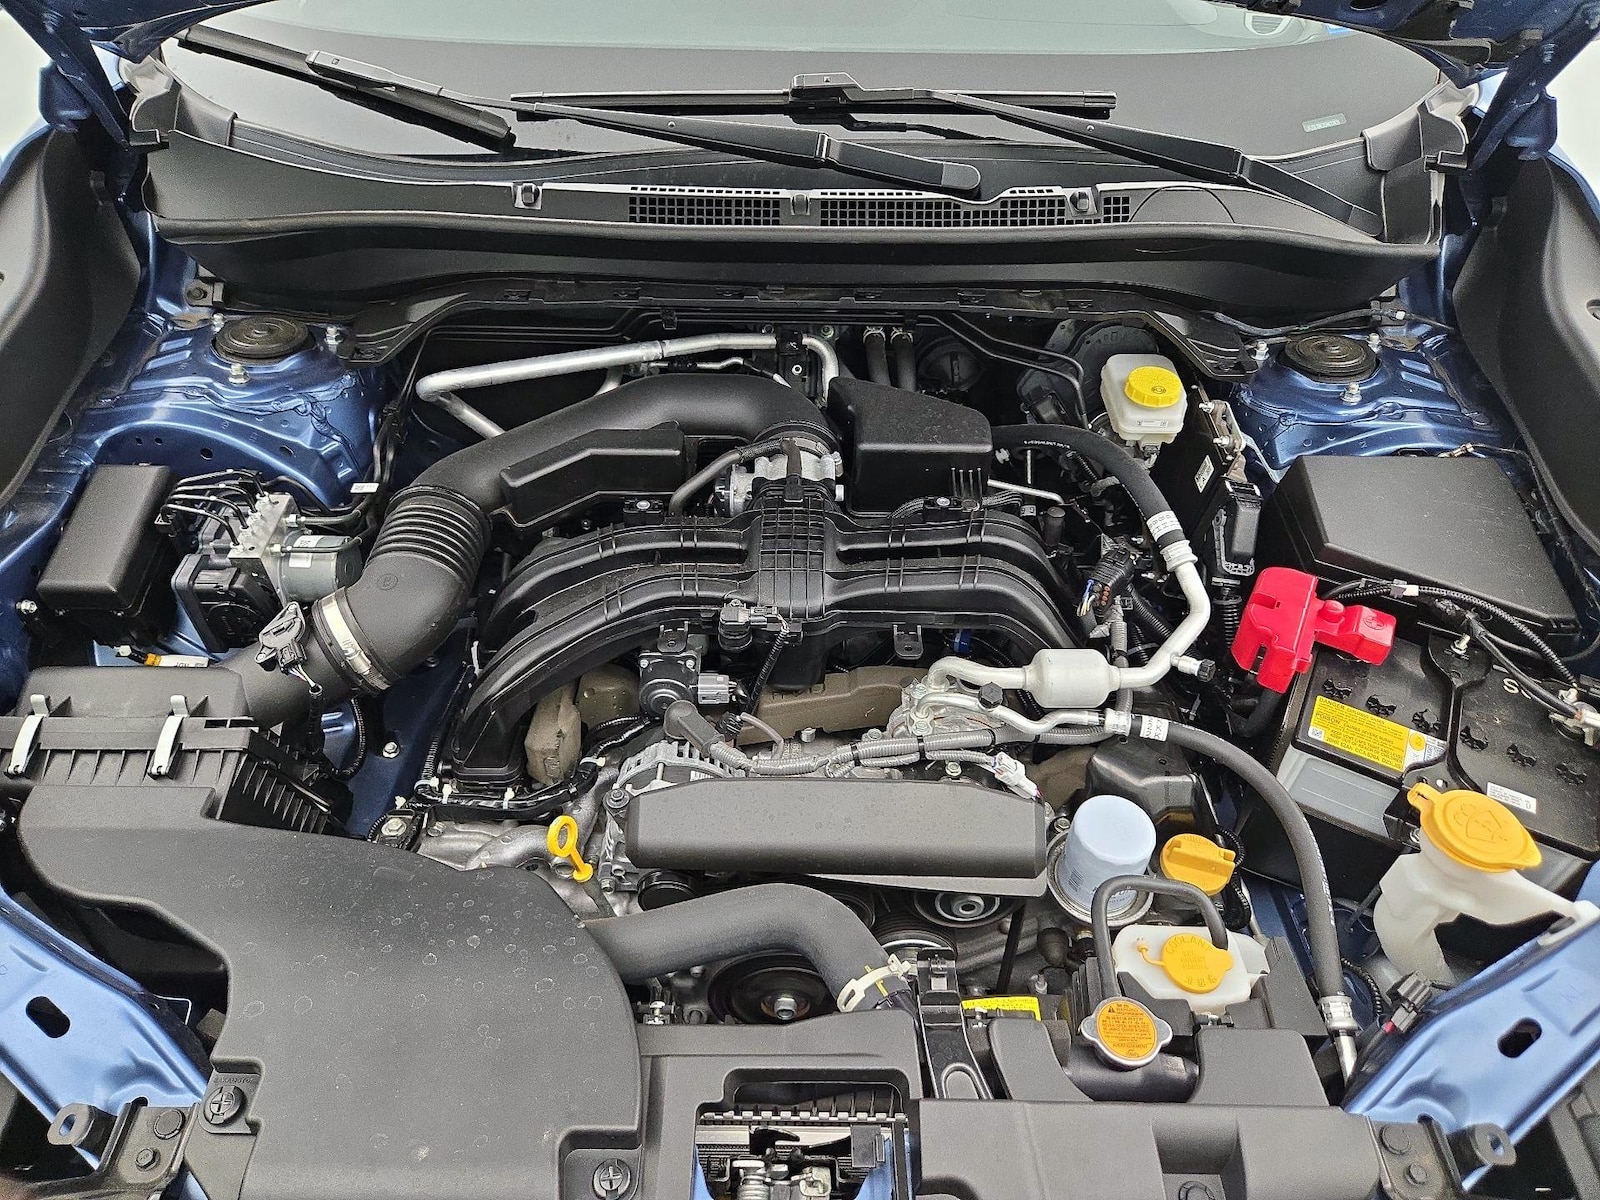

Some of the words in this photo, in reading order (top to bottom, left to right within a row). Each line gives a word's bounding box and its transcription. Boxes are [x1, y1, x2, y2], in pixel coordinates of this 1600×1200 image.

[1318, 696, 1345, 710] DANGER
[1315, 712, 1340, 724] POISON
[1166, 935, 1213, 954] COOLANT
